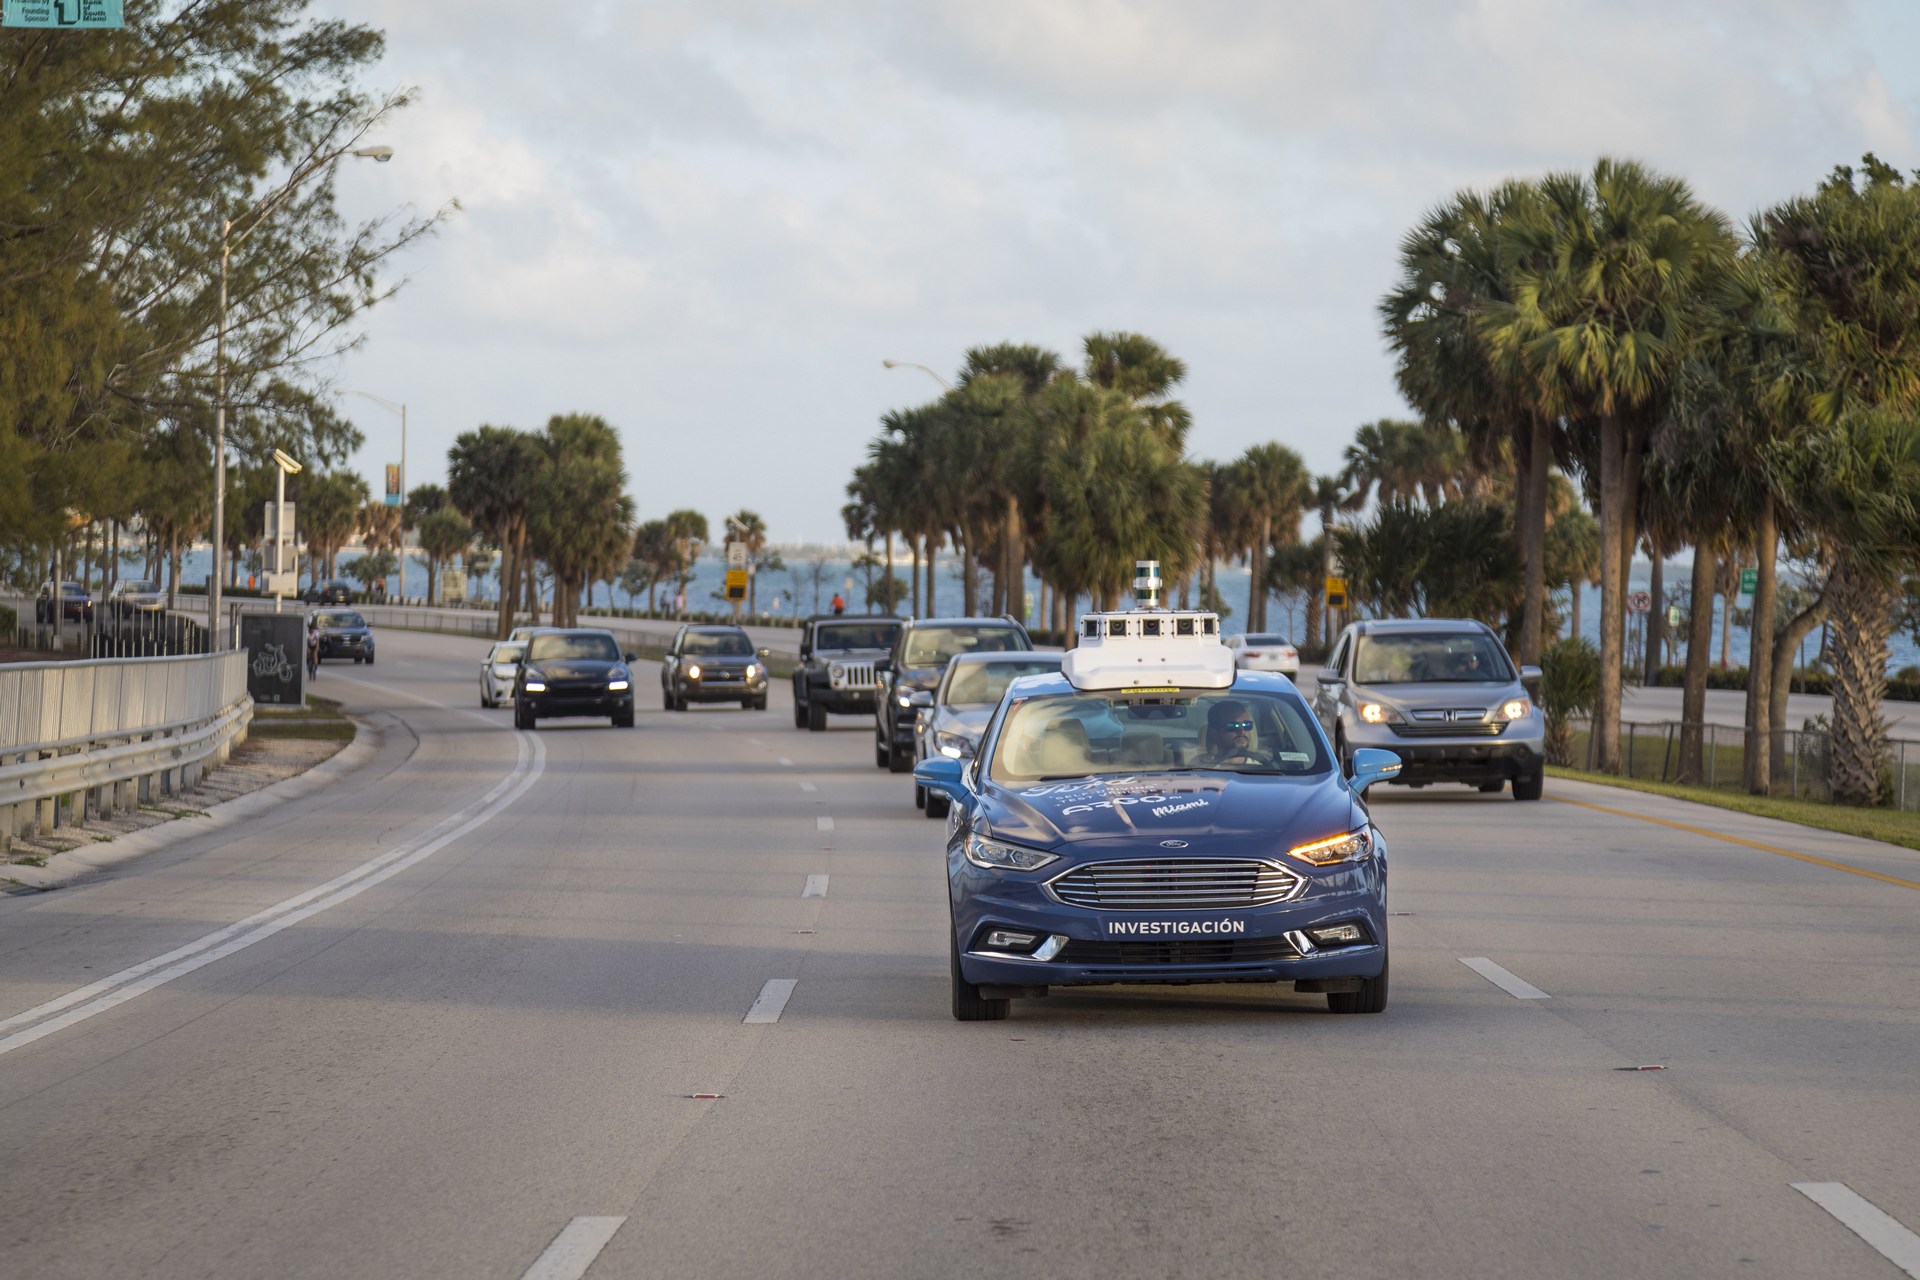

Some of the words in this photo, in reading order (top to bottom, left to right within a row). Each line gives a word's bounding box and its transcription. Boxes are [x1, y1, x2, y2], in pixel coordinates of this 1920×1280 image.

[22, 7, 50, 15] Founding
[1019, 776, 1138, 797] Ford
[1062, 796, 1167, 816] ARGO
[1151, 798, 1209, 818] Miami
[1108, 917, 1245, 934] INVESTIGACIÓN
